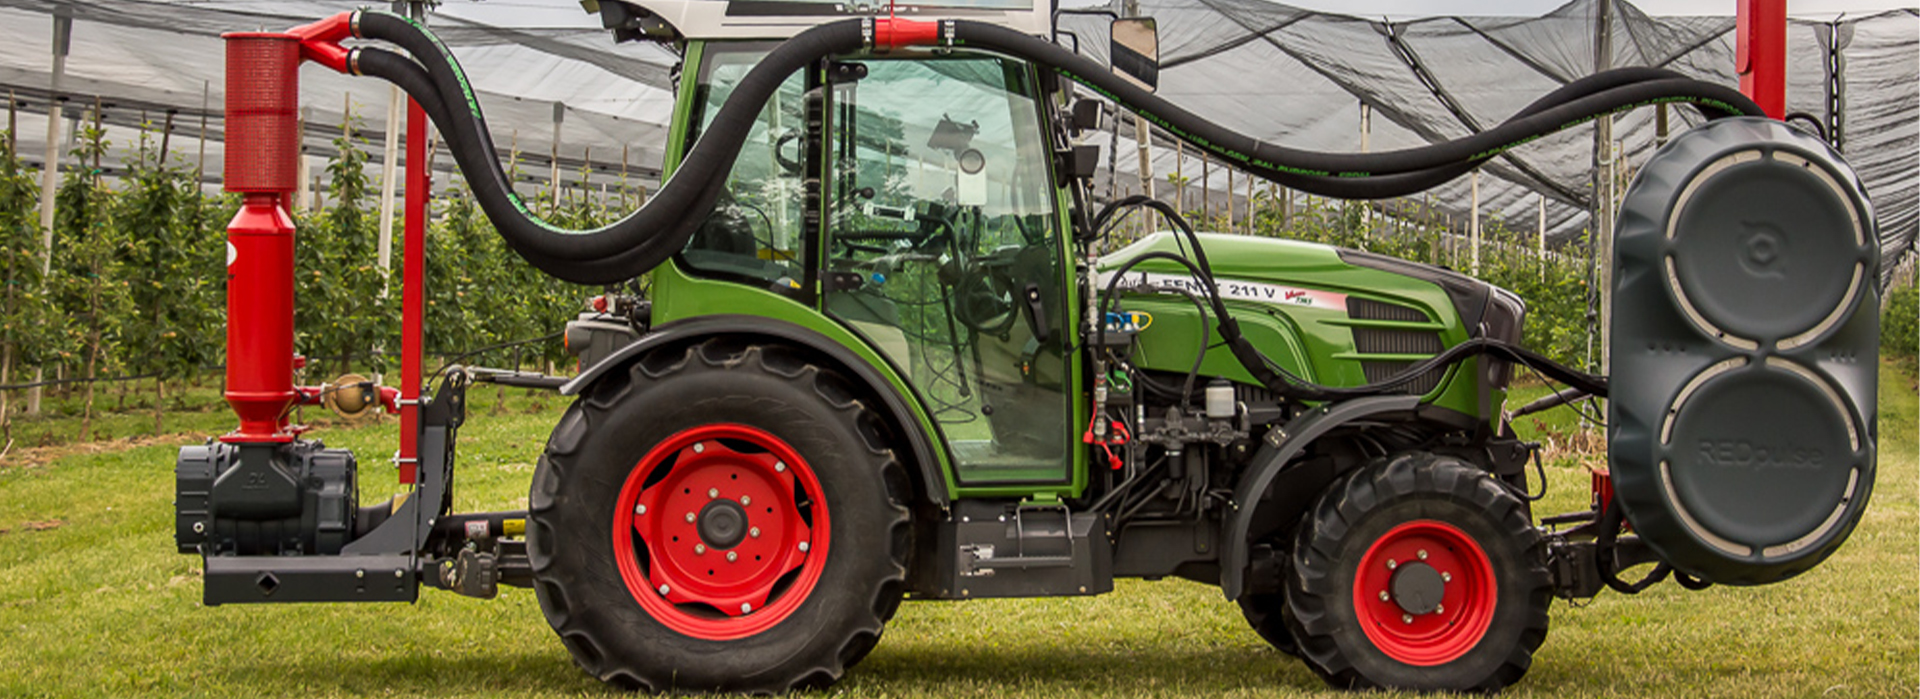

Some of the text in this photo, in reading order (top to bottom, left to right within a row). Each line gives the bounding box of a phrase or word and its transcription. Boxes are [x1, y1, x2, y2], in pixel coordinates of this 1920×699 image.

[1229, 284, 1259, 297] 211
[1264, 287, 1276, 299] V
[1698, 438, 1825, 471] REDpulse
